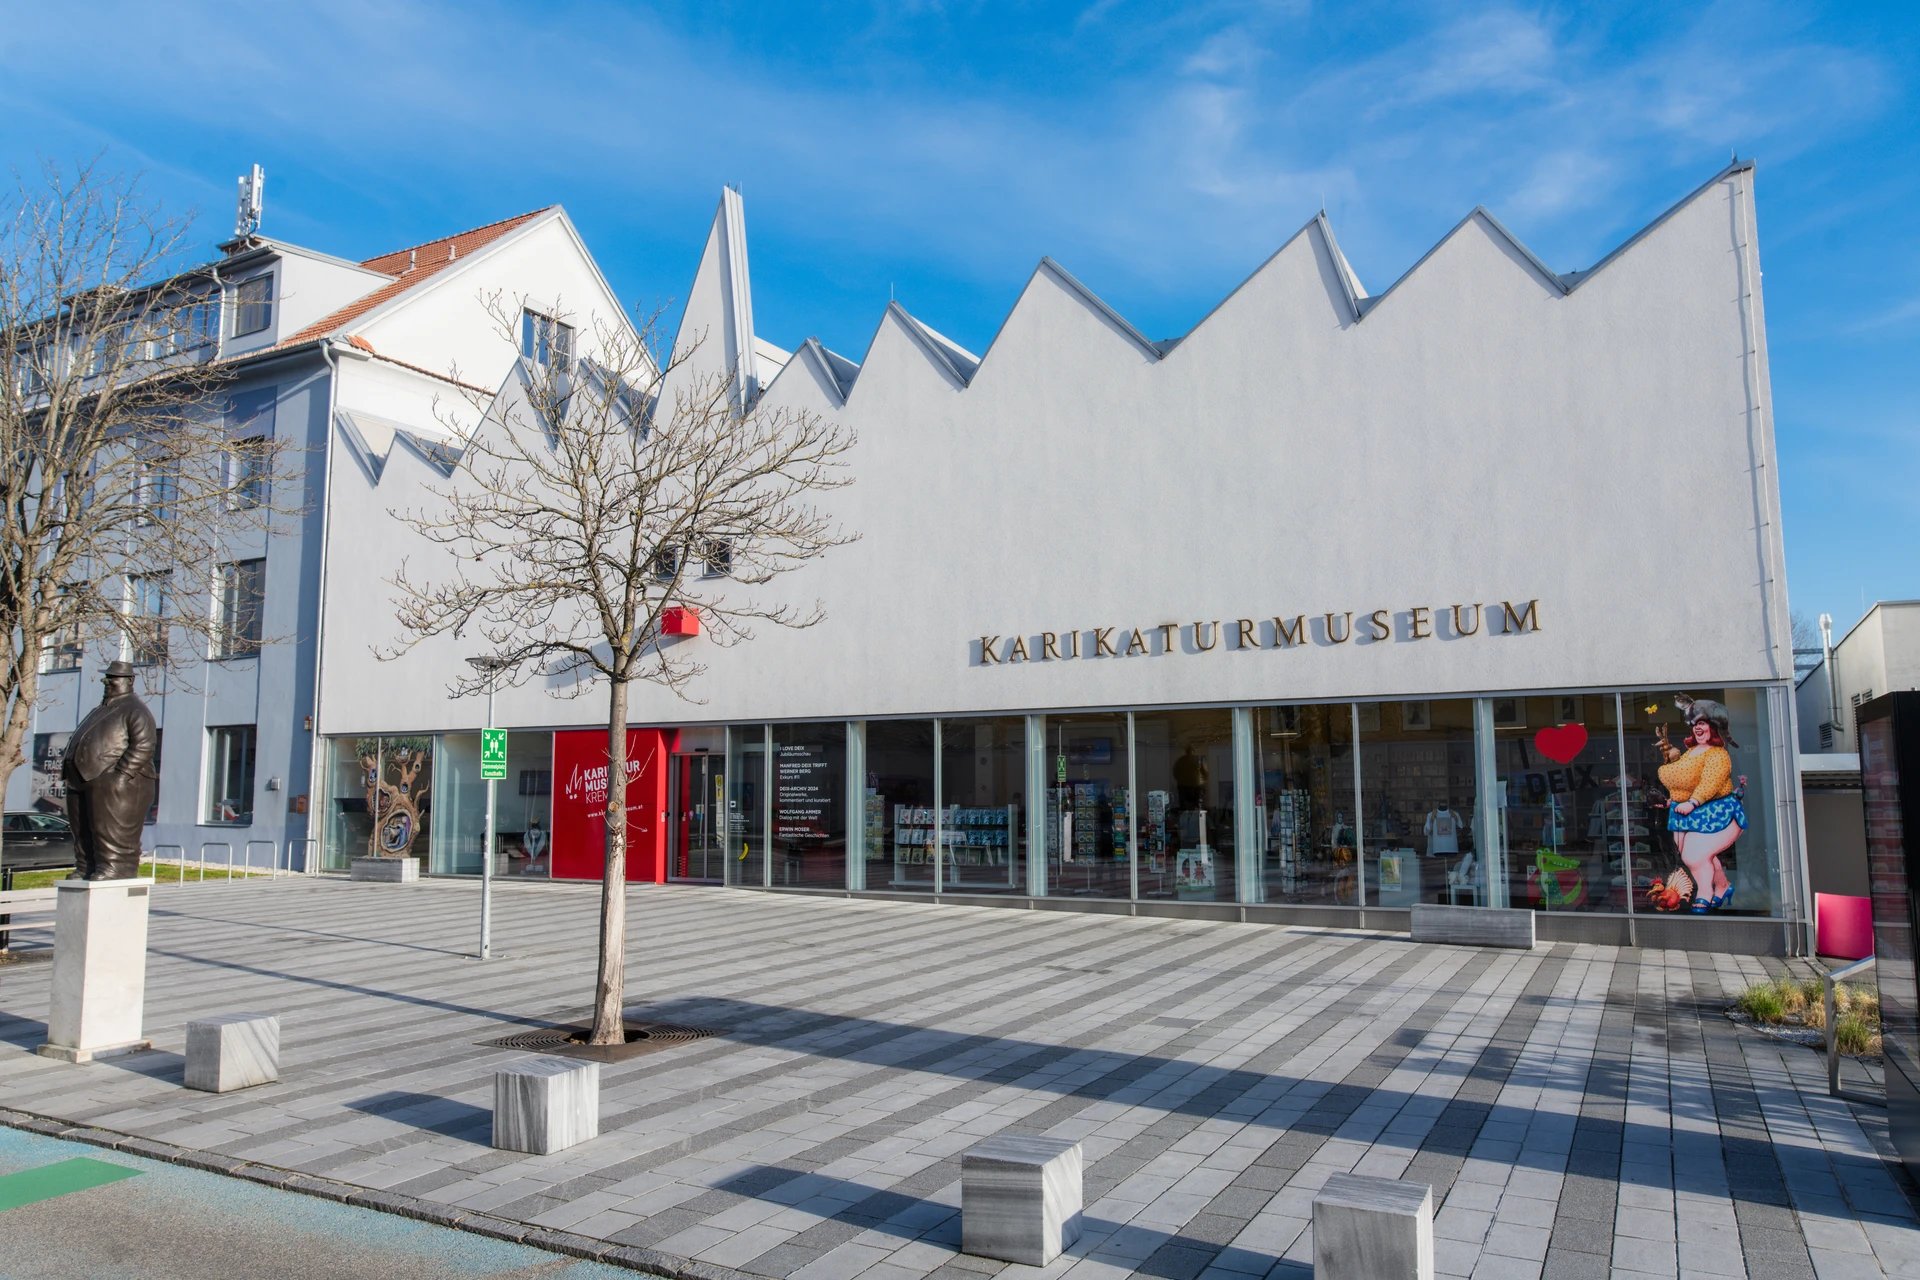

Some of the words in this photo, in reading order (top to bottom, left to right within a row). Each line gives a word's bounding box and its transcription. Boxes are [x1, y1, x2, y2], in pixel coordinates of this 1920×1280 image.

[979, 599, 1542, 665] KARIKATURMUSEUM
[48, 747, 61, 757] EINE
[44, 760, 63, 770] FRAGE
[584, 760, 640, 780] KARIUR
[1525, 764, 1599, 796] DEIX
[38, 787, 66, 797] ETIKETTE
[586, 791, 608, 804] KREM
